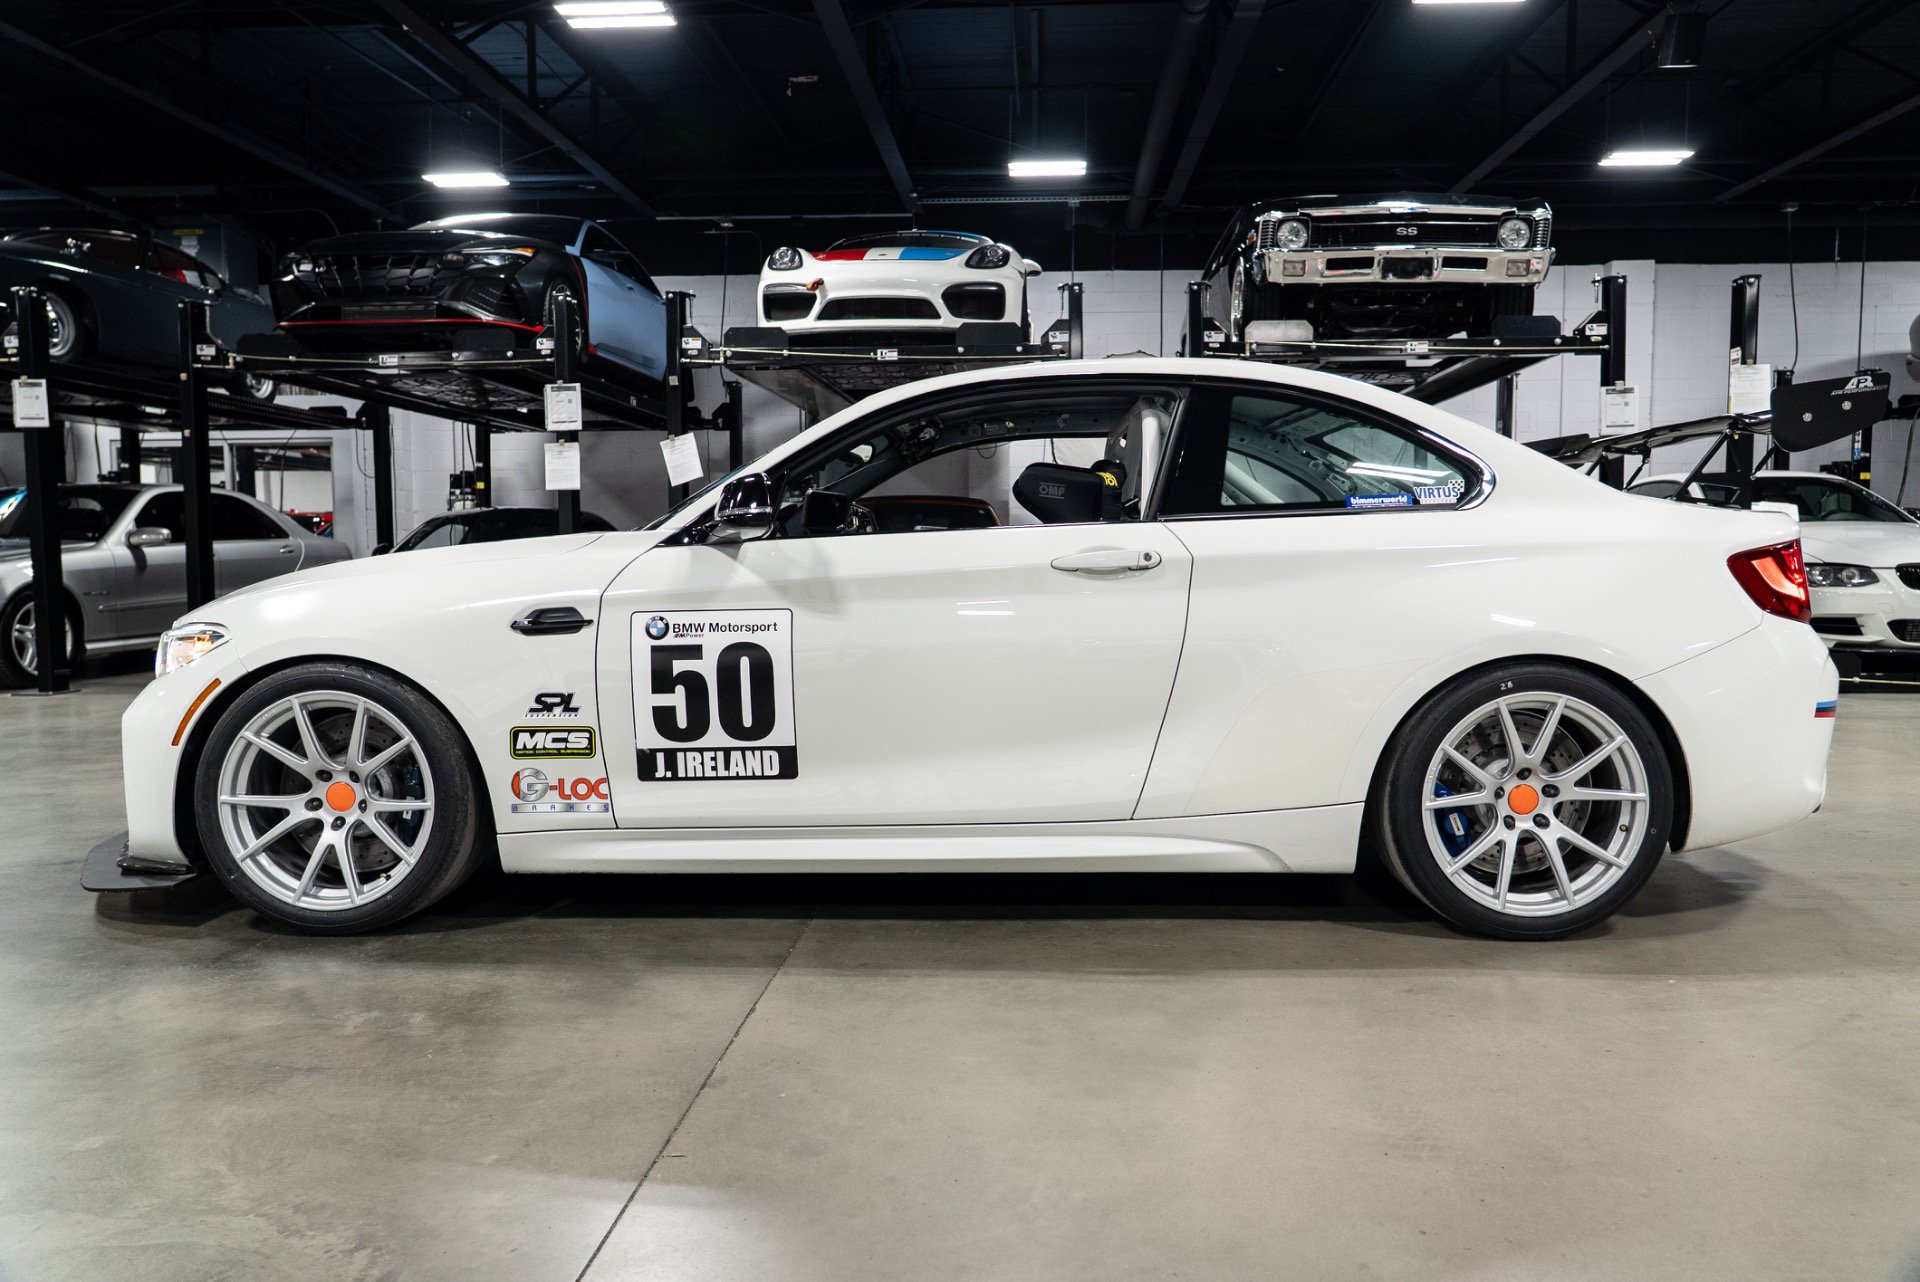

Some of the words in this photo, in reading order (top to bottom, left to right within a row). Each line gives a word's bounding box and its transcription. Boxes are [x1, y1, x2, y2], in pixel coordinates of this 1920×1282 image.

[1396, 227, 1418, 235] SS
[1039, 485, 1065, 496] OMP
[1414, 486, 1459, 499] VIRTUS
[1350, 495, 1408, 504] bimmerworld
[672, 623, 706, 634] BMW
[708, 621, 778, 634] Motorsport
[650, 641, 776, 743] 50
[528, 692, 580, 713] SPL
[515, 732, 590, 750] MCS
[655, 752, 672, 778] J.
[677, 750, 780, 777] IRELAND
[510, 767, 609, 802] G-LOC
